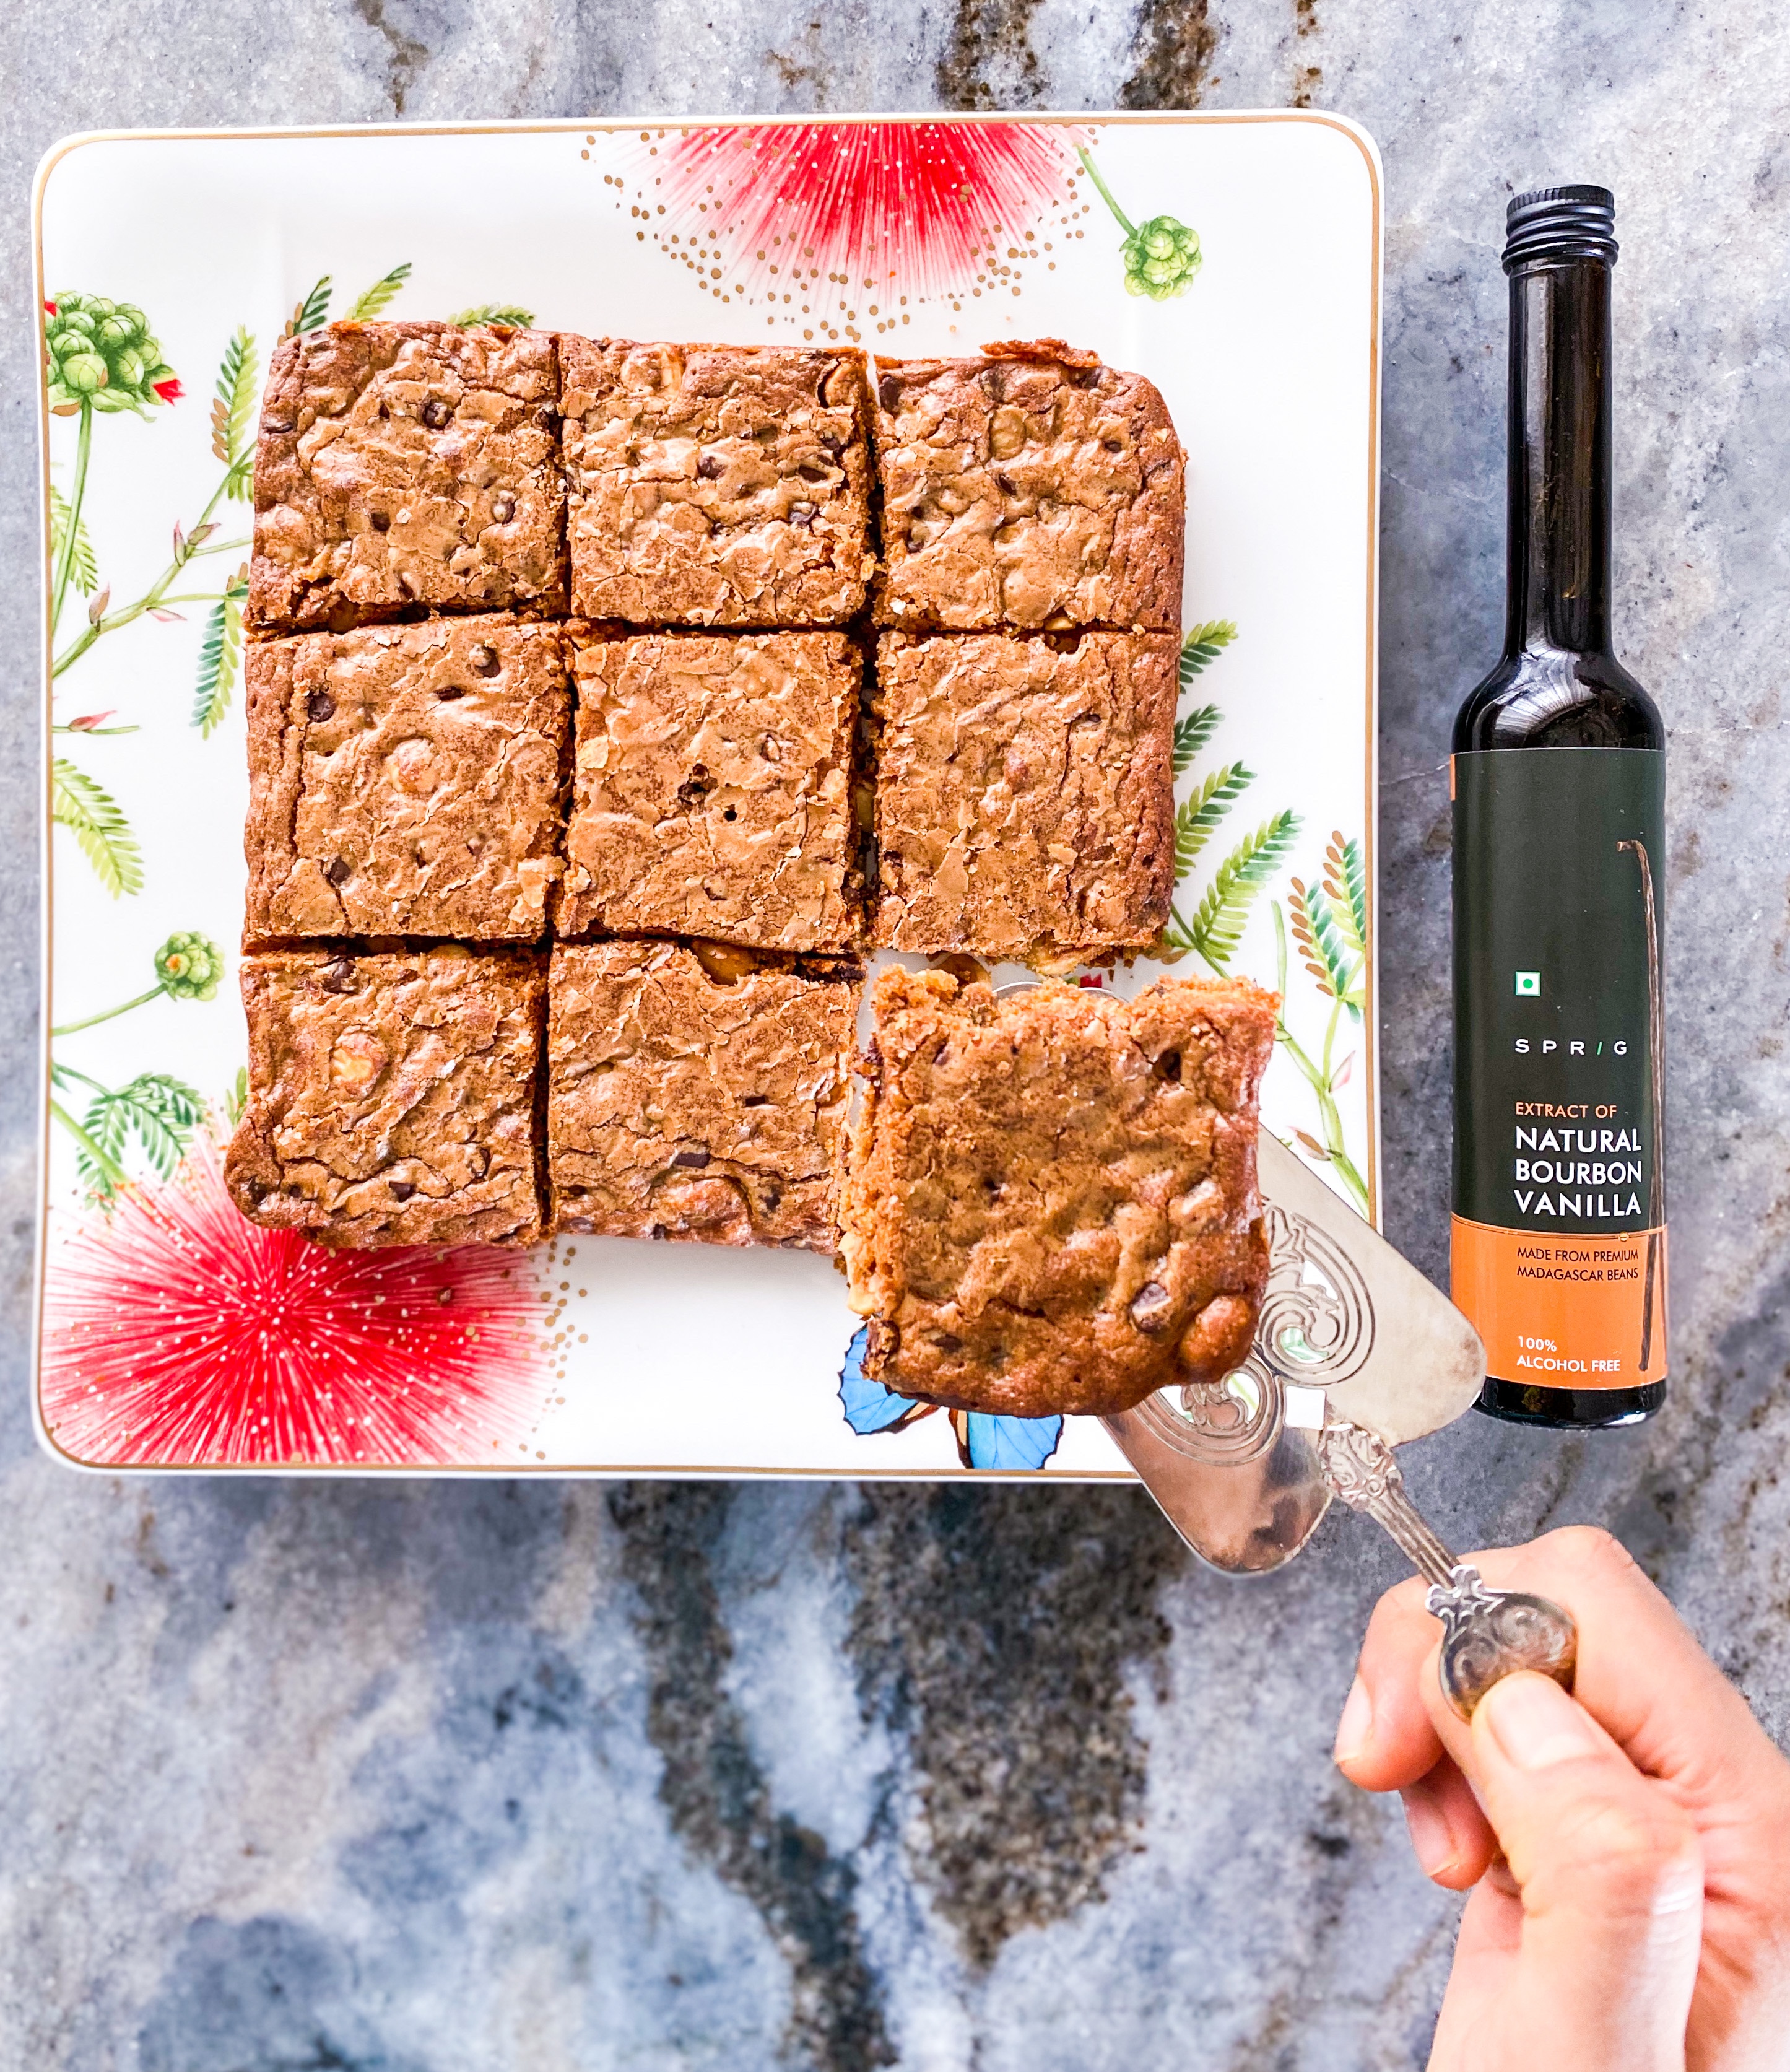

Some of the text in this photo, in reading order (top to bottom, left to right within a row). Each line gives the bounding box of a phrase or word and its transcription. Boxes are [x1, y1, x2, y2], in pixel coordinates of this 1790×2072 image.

[1516, 1102, 1617, 1118] EXTRACT OF
[1516, 1126, 1642, 1153] NATURAL
[1516, 1159, 1642, 1185] BOURBON
[1514, 1190, 1641, 1217] VANILLA
[1517, 1247, 1638, 1262] MADE FROM PREMIUM
[1517, 1265, 1638, 1281] MADAGASCAR BEANS
[1518, 1336, 1557, 1352] 100%
[1517, 1355, 1620, 1372] ALCOHOL FREE
